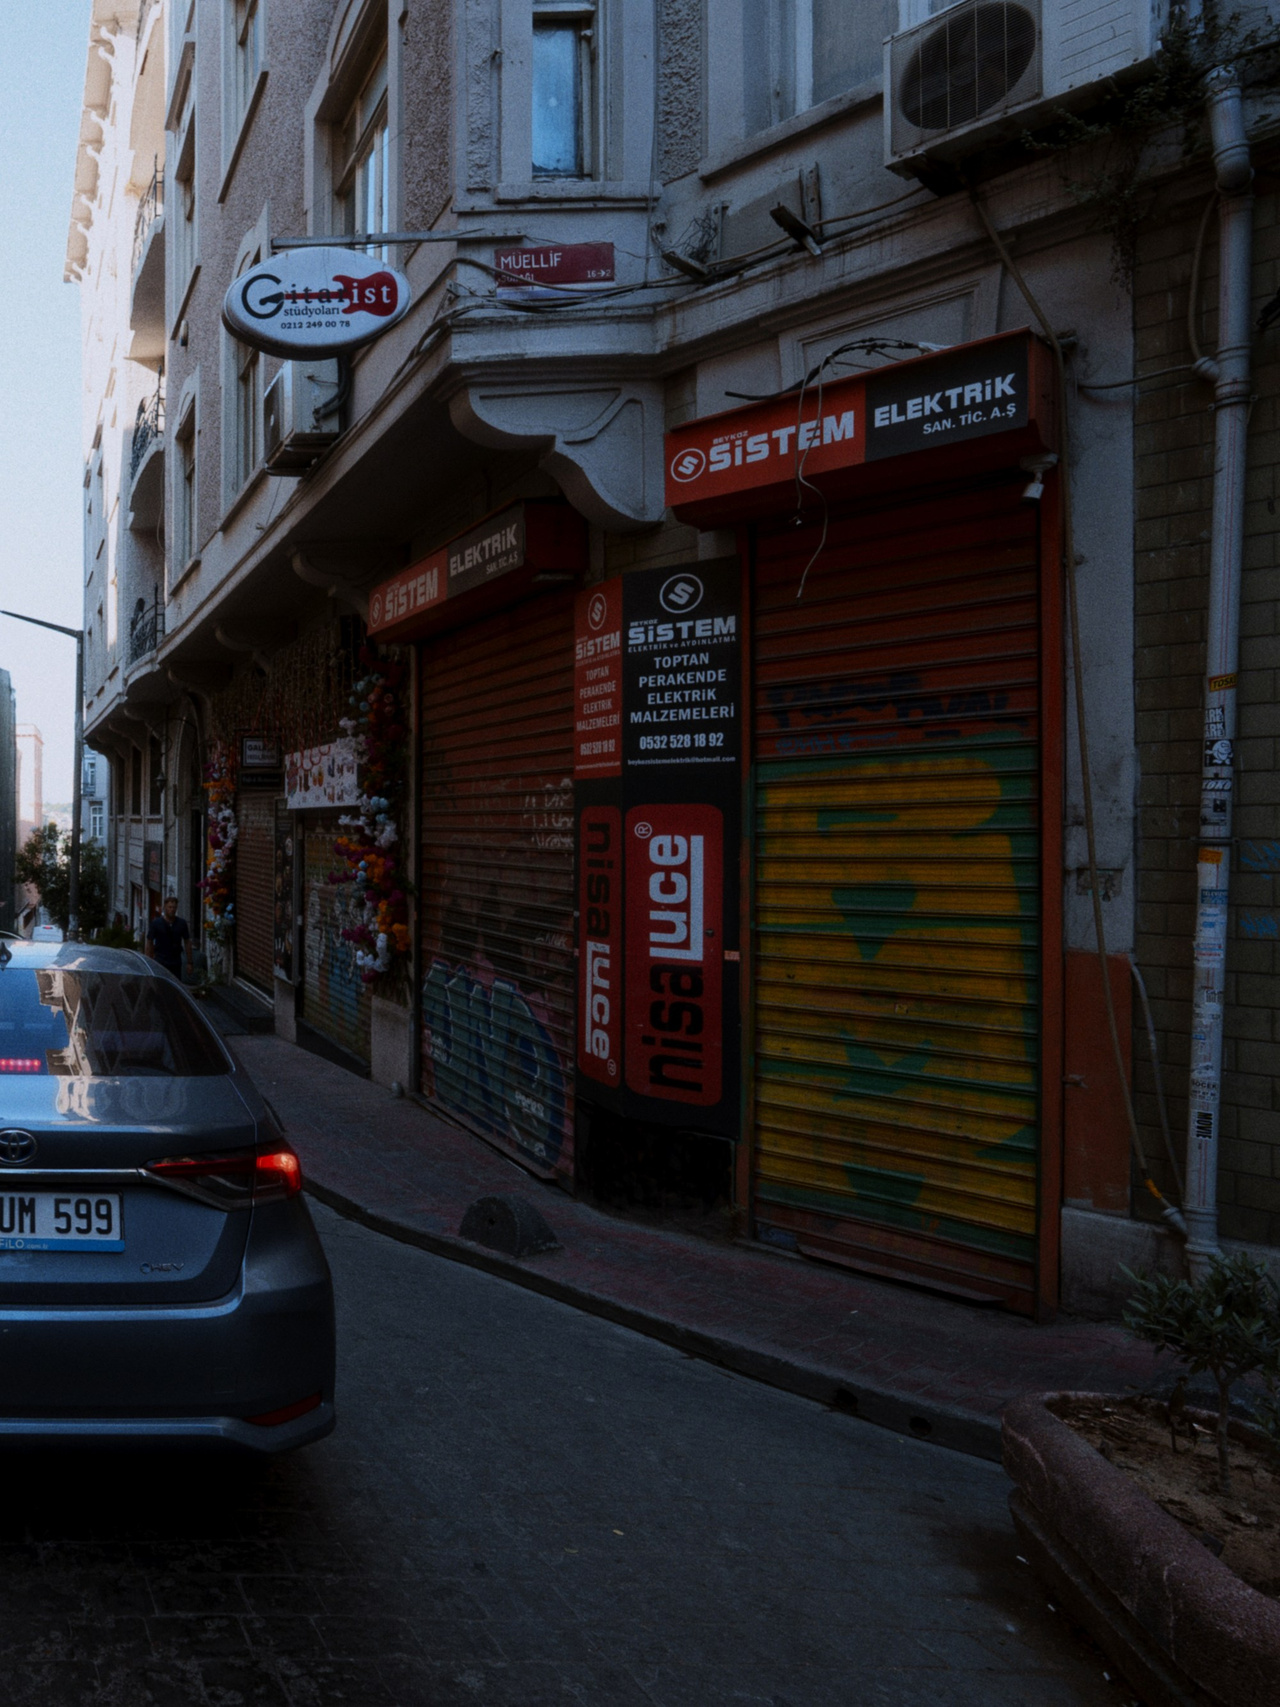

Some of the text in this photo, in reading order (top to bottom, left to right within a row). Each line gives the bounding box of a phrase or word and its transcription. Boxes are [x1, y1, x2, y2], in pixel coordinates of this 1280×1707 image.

[500, 249, 563, 270] MÜELLİF
[587, 269, 597, 278] 16
[241, 273, 392, 319] Gitarist
[283, 304, 340, 318] stüdyoları
[280, 319, 351, 330] 0212 249 00 78
[922, 417, 956, 436] SAN.
[959, 407, 987, 426] TİC.
[680, 635, 737, 648] AYDINLATMA
[653, 651, 710, 670] TOPTAN
[585, 665, 610, 682] TOPTAN
[638, 668, 727, 688] PERAKENDE
[579, 680, 617, 699] PERAKENDE
[629, 702, 735, 725] MALZEMELERİ
[639, 732, 725, 750] 0532 528 18 92
[54, 1198, 113, 1235] 599
